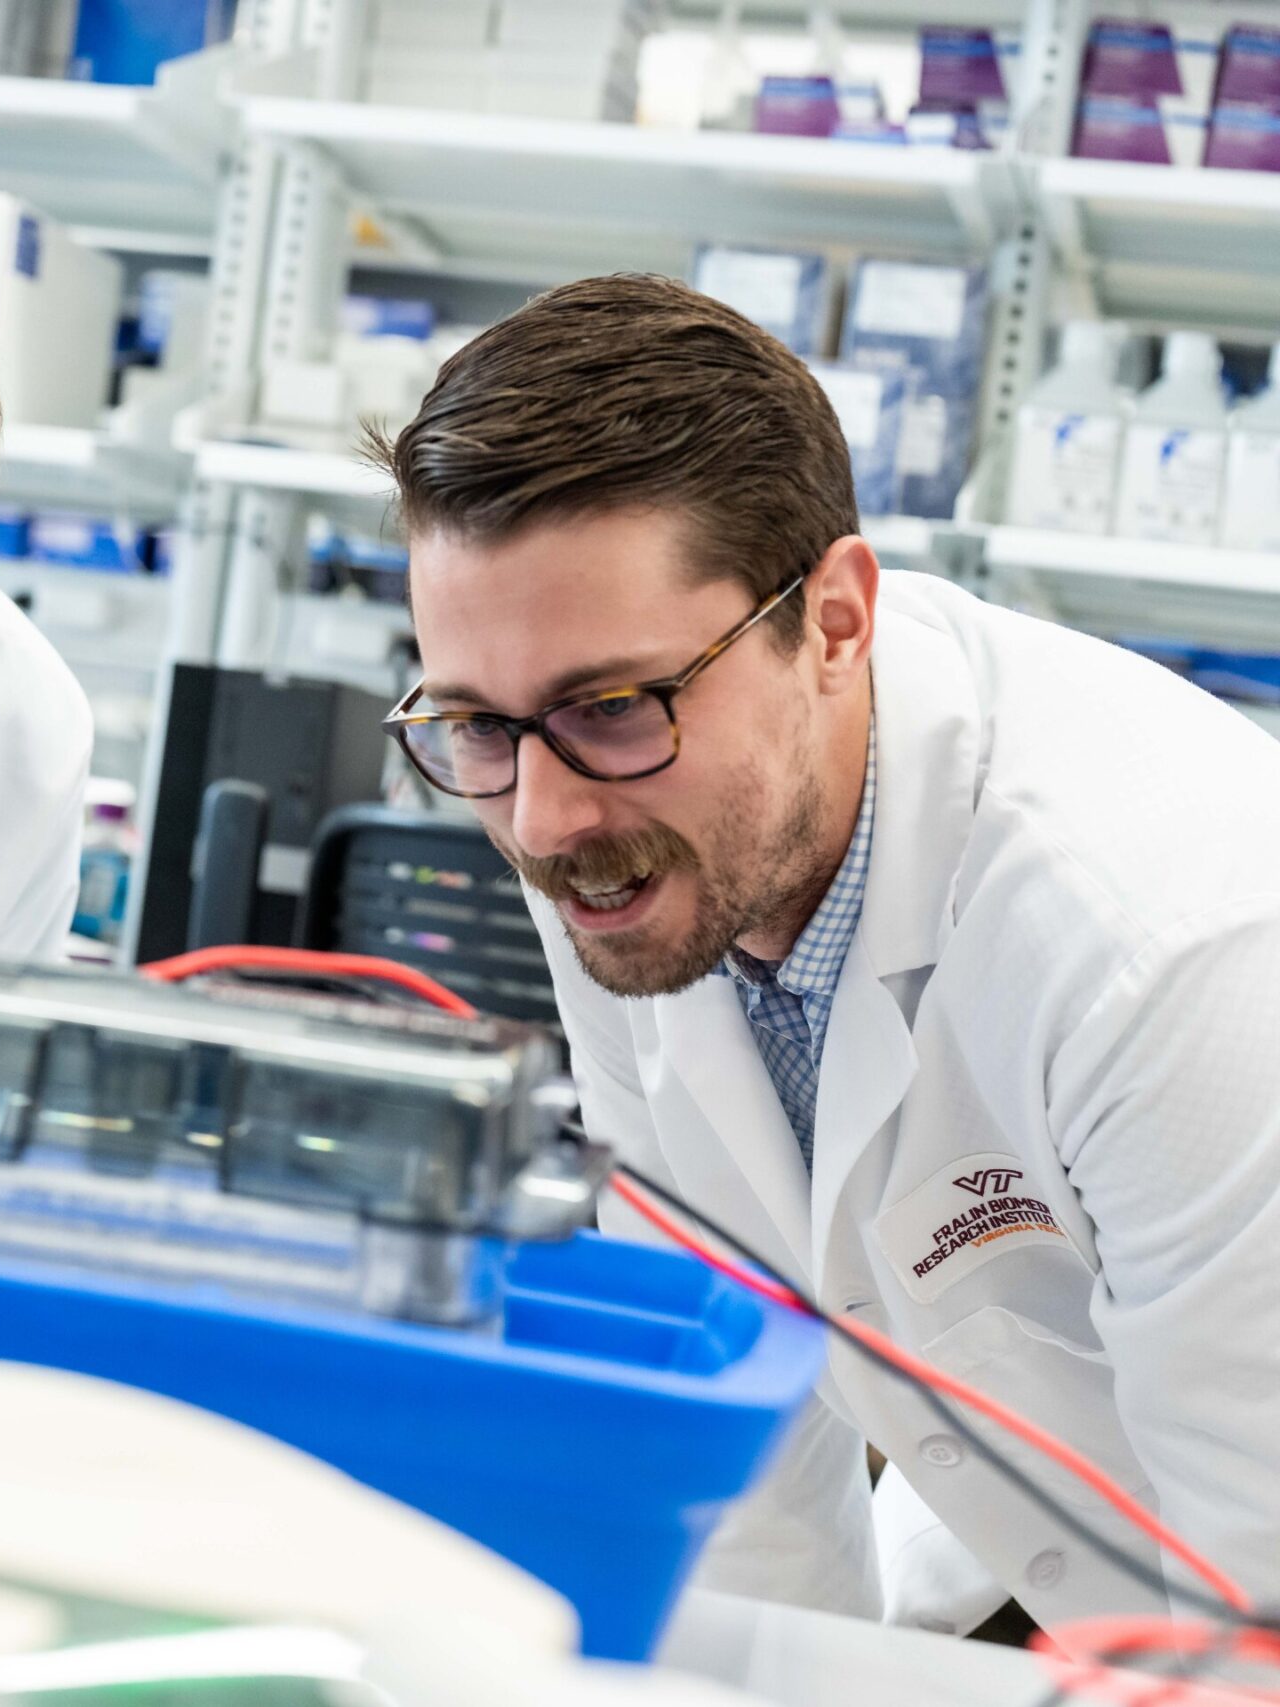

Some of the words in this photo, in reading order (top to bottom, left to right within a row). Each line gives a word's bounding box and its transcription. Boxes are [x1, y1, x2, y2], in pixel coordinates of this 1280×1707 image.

[952, 1169, 1023, 1196] VT
[932, 1203, 988, 1245] FRALIN
[971, 1223, 1035, 1248] VIRGINIA
[913, 1219, 991, 1278] RESEARCH
